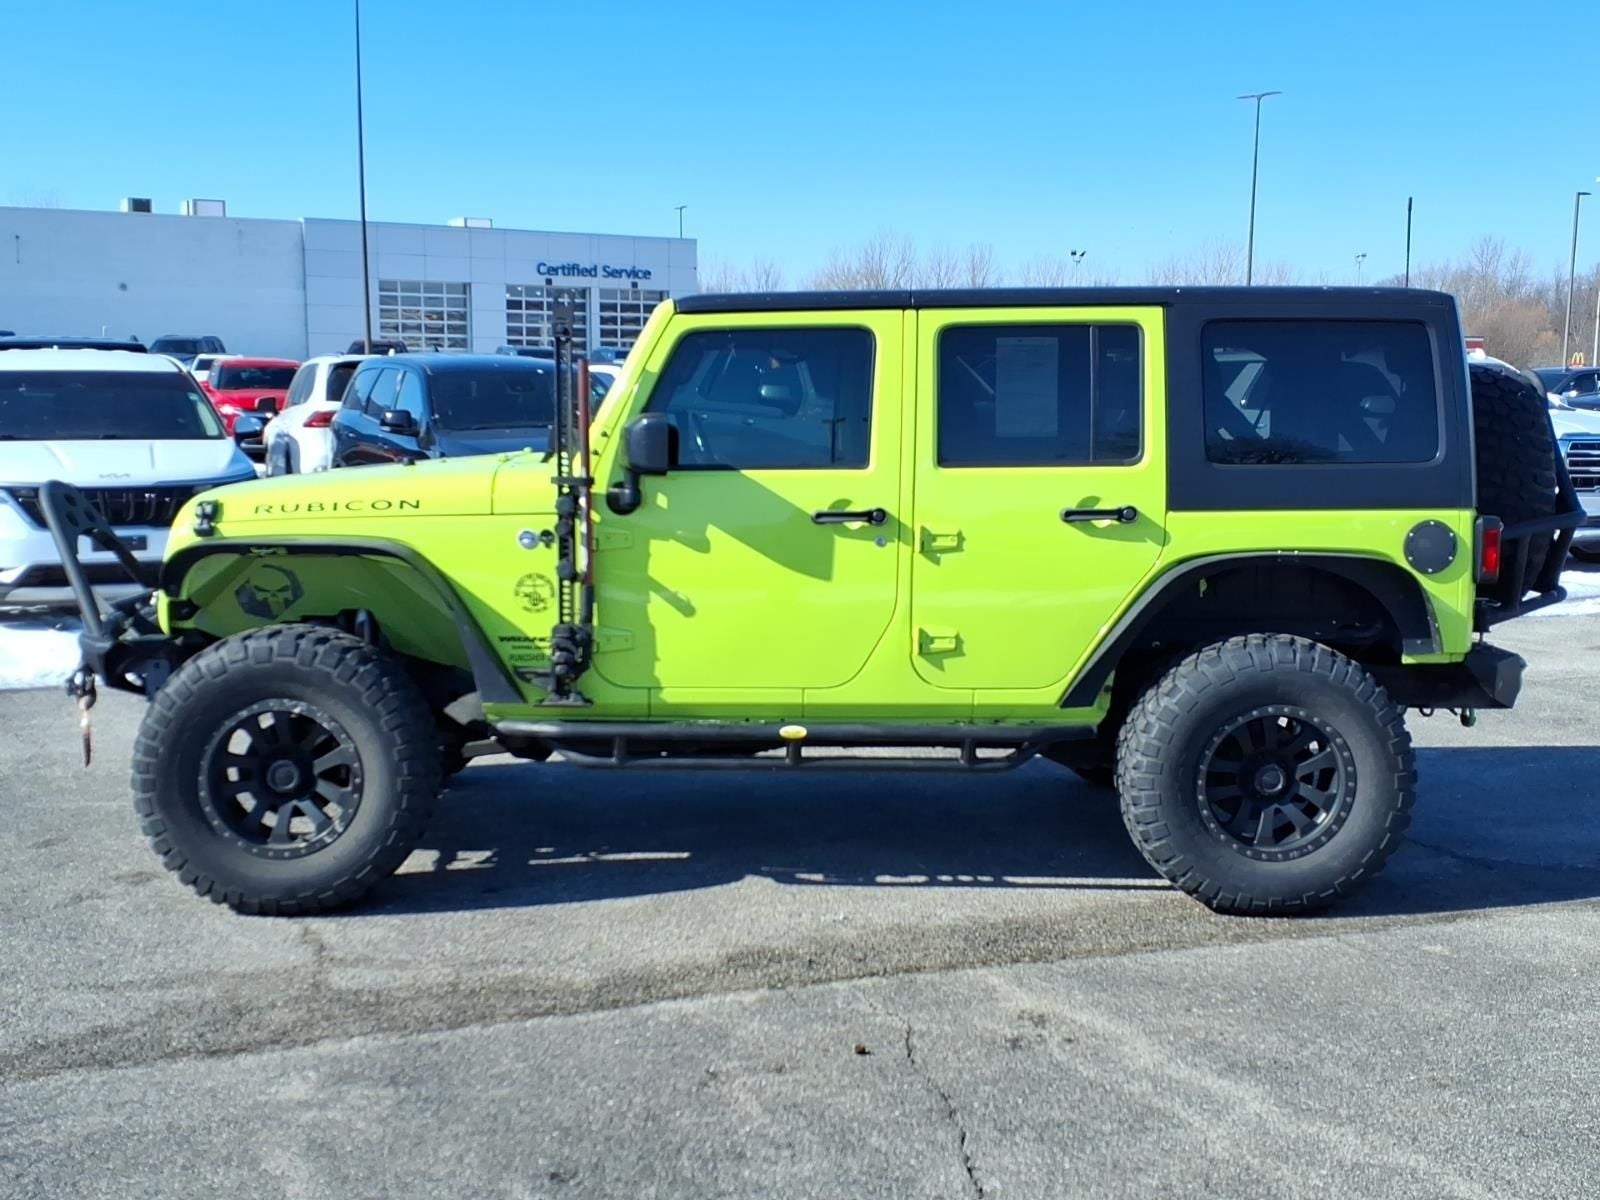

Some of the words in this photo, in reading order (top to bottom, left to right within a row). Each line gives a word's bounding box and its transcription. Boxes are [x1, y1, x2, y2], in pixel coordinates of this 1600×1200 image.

[537, 262, 598, 277] Certified
[602, 265, 652, 280] Service
[254, 499, 420, 514] RUBICON
